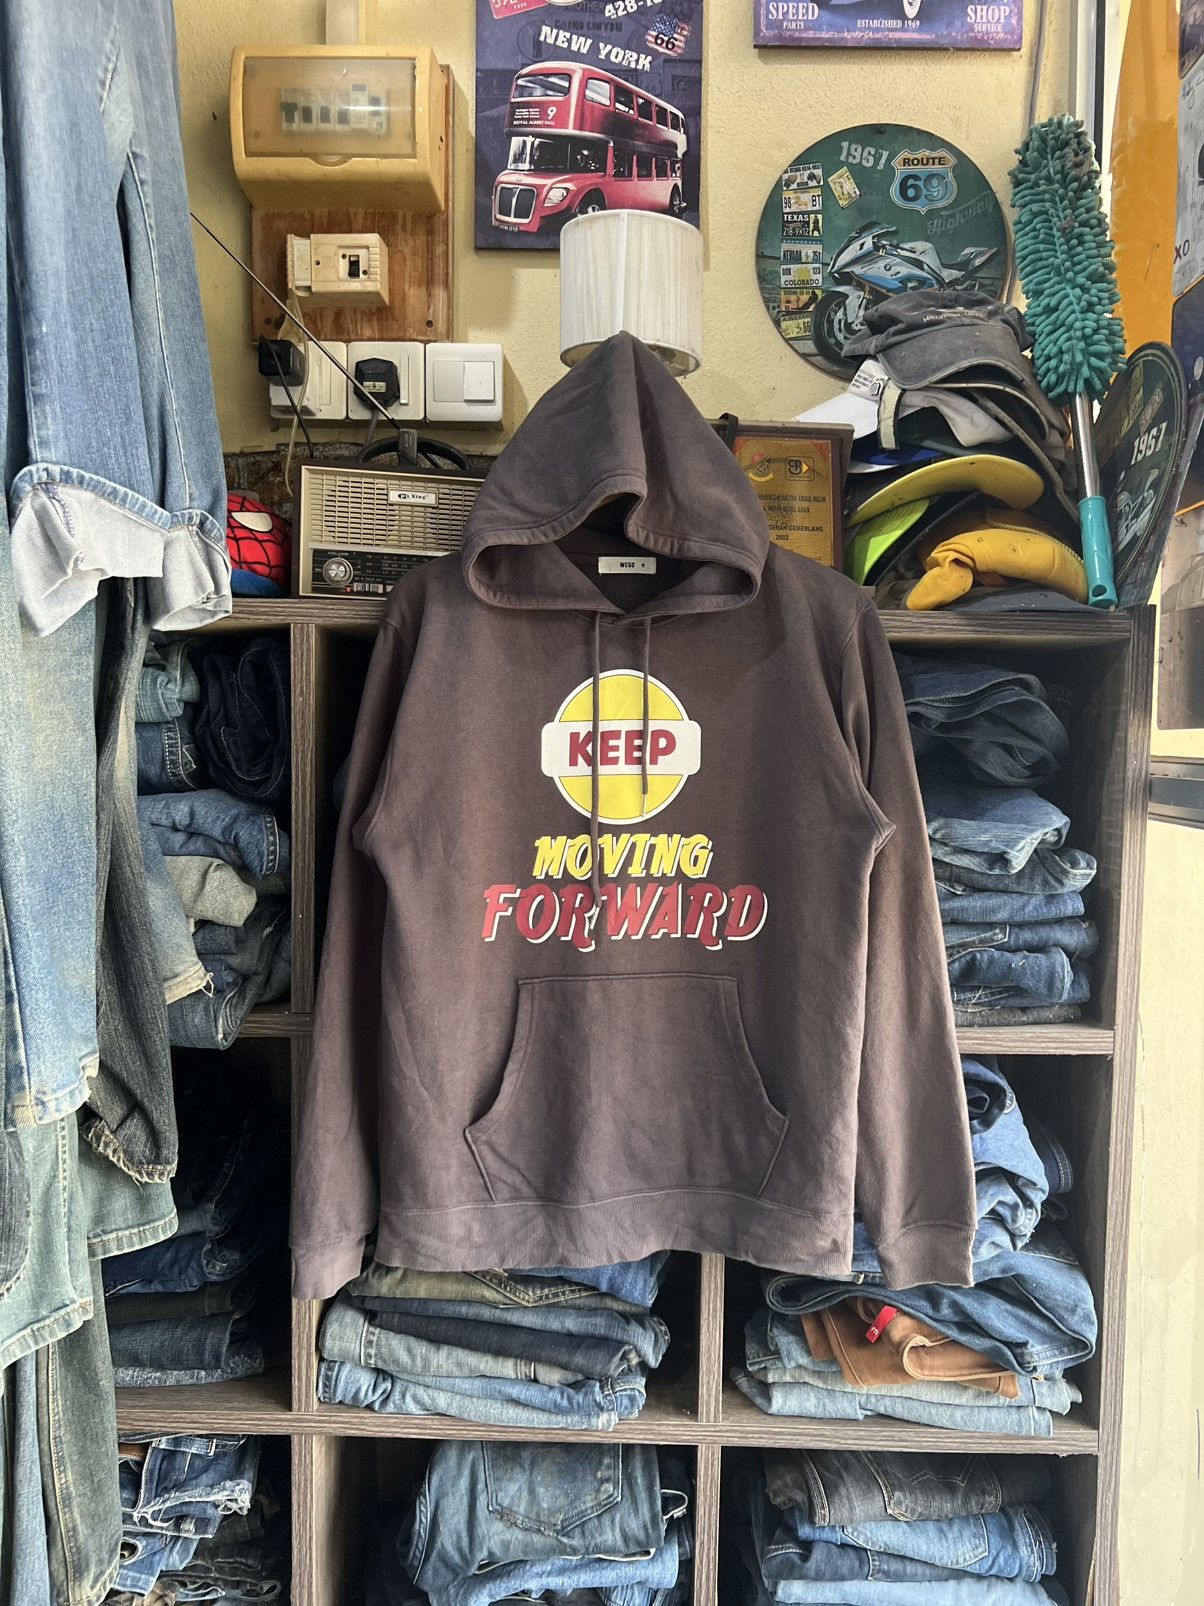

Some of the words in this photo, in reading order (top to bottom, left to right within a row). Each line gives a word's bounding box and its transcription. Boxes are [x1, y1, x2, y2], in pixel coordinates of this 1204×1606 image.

[768, 2, 819, 20] SPEED
[967, 5, 1010, 23] SHOP
[783, 22, 804, 30] PARTS
[857, 19, 902, 28] ESTABLISHED
[904, 20, 920, 28] 1969
[974, 24, 1003, 32] SERVICE
[539, 25, 593, 54] NEW
[598, 42, 653, 72] YORK
[654, 33, 678, 50] 66
[547, 106, 557, 120] 9
[840, 141, 890, 170] 1967
[902, 156, 946, 167] ROUTE
[900, 173, 948, 202] 69
[1130, 421, 1168, 466] 1967
[789, 524, 824, 532] CEMERLANG
[568, 729, 677, 767] KEEP
[532, 834, 714, 880] MOVING
[481, 880, 769, 952] FORWARD
